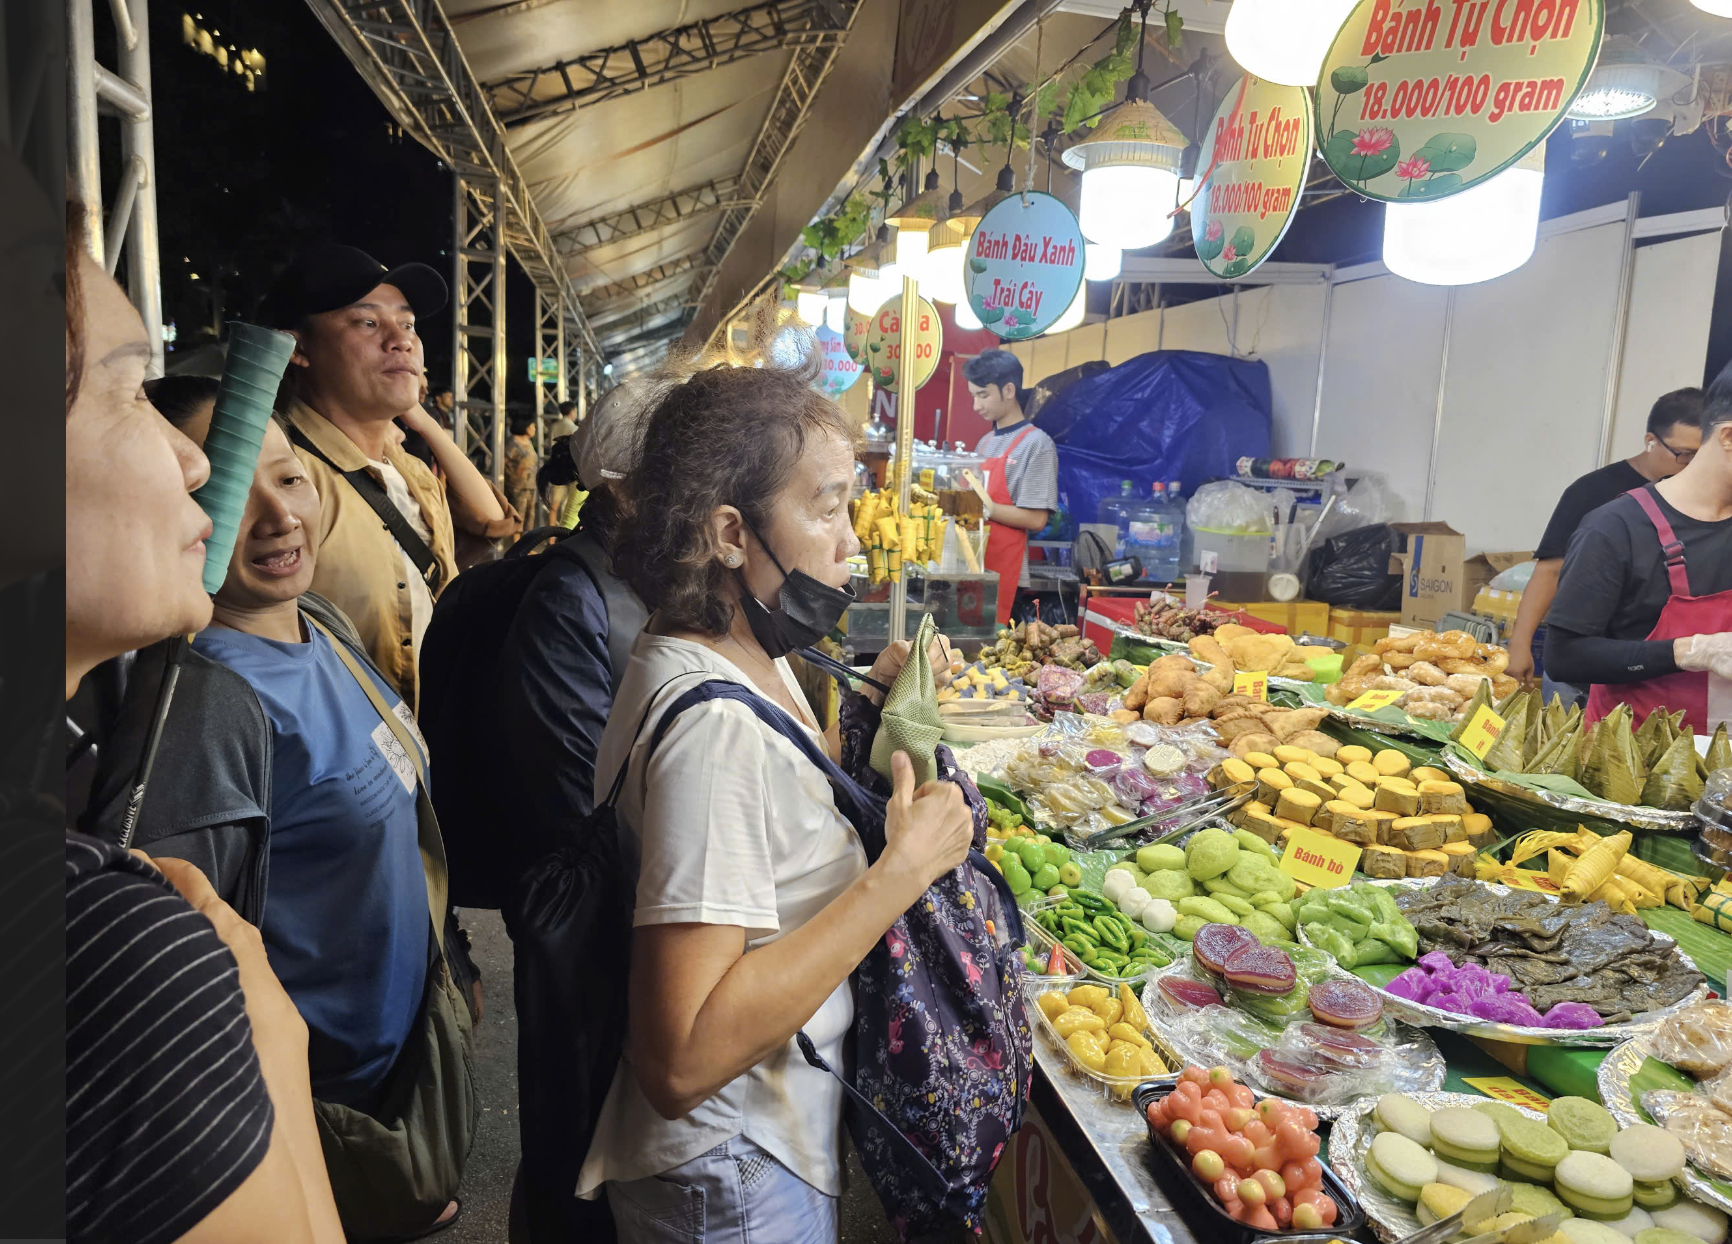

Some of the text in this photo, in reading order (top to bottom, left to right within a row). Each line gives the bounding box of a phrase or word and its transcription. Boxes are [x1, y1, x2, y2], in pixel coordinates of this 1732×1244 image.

[1360, 0, 1579, 61] Bánh Tự Chọn
[1360, 73, 1565, 123] 18.000/100 gram
[1245, 111, 1265, 170] Tự
[1263, 106, 1300, 168] Chọn
[1209, 180, 1292, 220] 18.000/100 gram
[976, 231, 1076, 268] Bánh Đậu Xanh
[991, 278, 1044, 317] Trái Cây
[1420, 577, 1453, 593] SAIGON
[117, 804, 137, 849] EXCLUSIVE
[1293, 846, 1326, 868] Bánh
